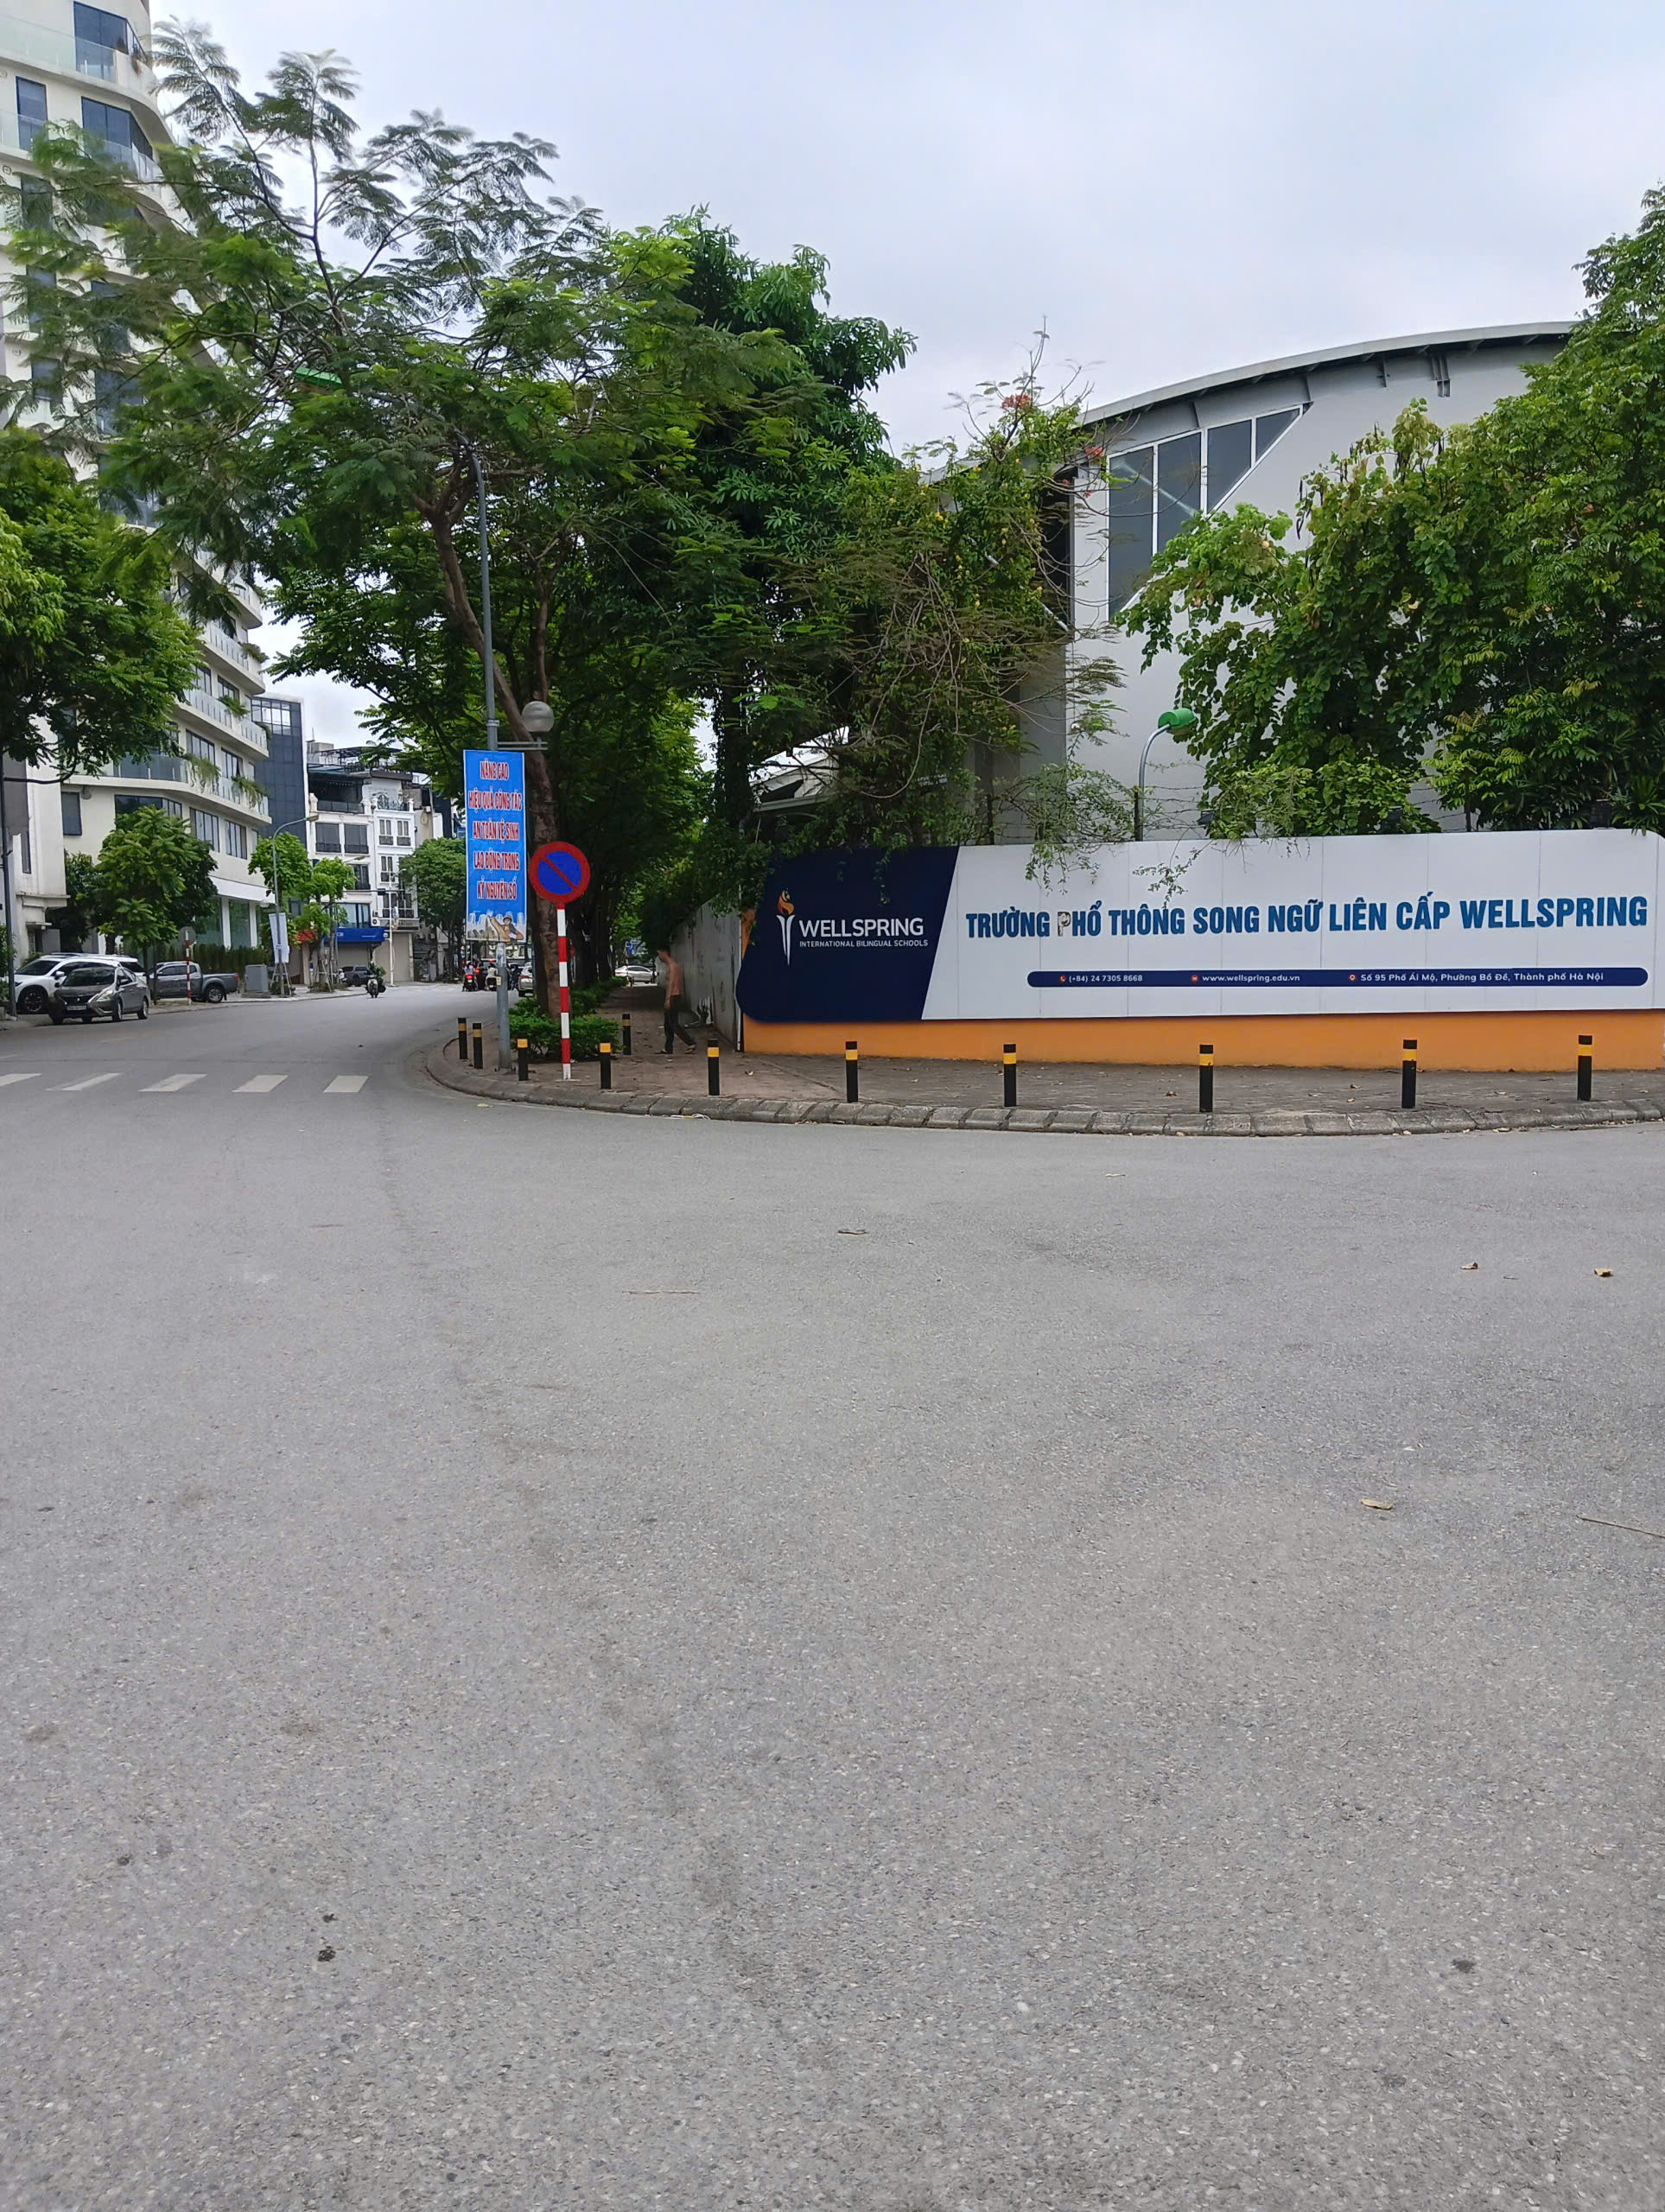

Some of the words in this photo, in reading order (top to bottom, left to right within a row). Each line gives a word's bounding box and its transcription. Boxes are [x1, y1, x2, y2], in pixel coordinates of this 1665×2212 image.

[480, 758, 497, 780] NÂNG
[497, 761, 509, 781] CAO
[494, 788, 511, 810] CÔNG
[473, 821, 481, 840] AN
[505, 823, 519, 841] SINH
[473, 850, 484, 869] LAO
[966, 906, 1051, 938] TRƯỜNG
[1057, 899, 1103, 937] PHỔ
[1109, 904, 1185, 936] THÔNG
[1193, 906, 1260, 934] SONG
[1268, 899, 1323, 933] NGỮ
[1329, 897, 1387, 931] LIÊN
[1395, 891, 1451, 931] CẤP
[1459, 895, 1648, 929] WELLSPRING
[798, 918, 925, 938] WELLSPRING
[1069, 975, 1089, 983] (+84)
[1202, 974, 1300, 983] www.wellspring.edu.vn
[1360, 973, 1372, 982] Số
[1389, 973, 1408, 982] Phố
[1408, 972, 1419, 982] Ái
[1440, 973, 1477, 982] Phường
[1513, 972, 1545, 982] Thành
[1547, 972, 1567, 982] phố
[1569, 972, 1584, 981] Hà
[1586, 972, 1604, 982] Nội
